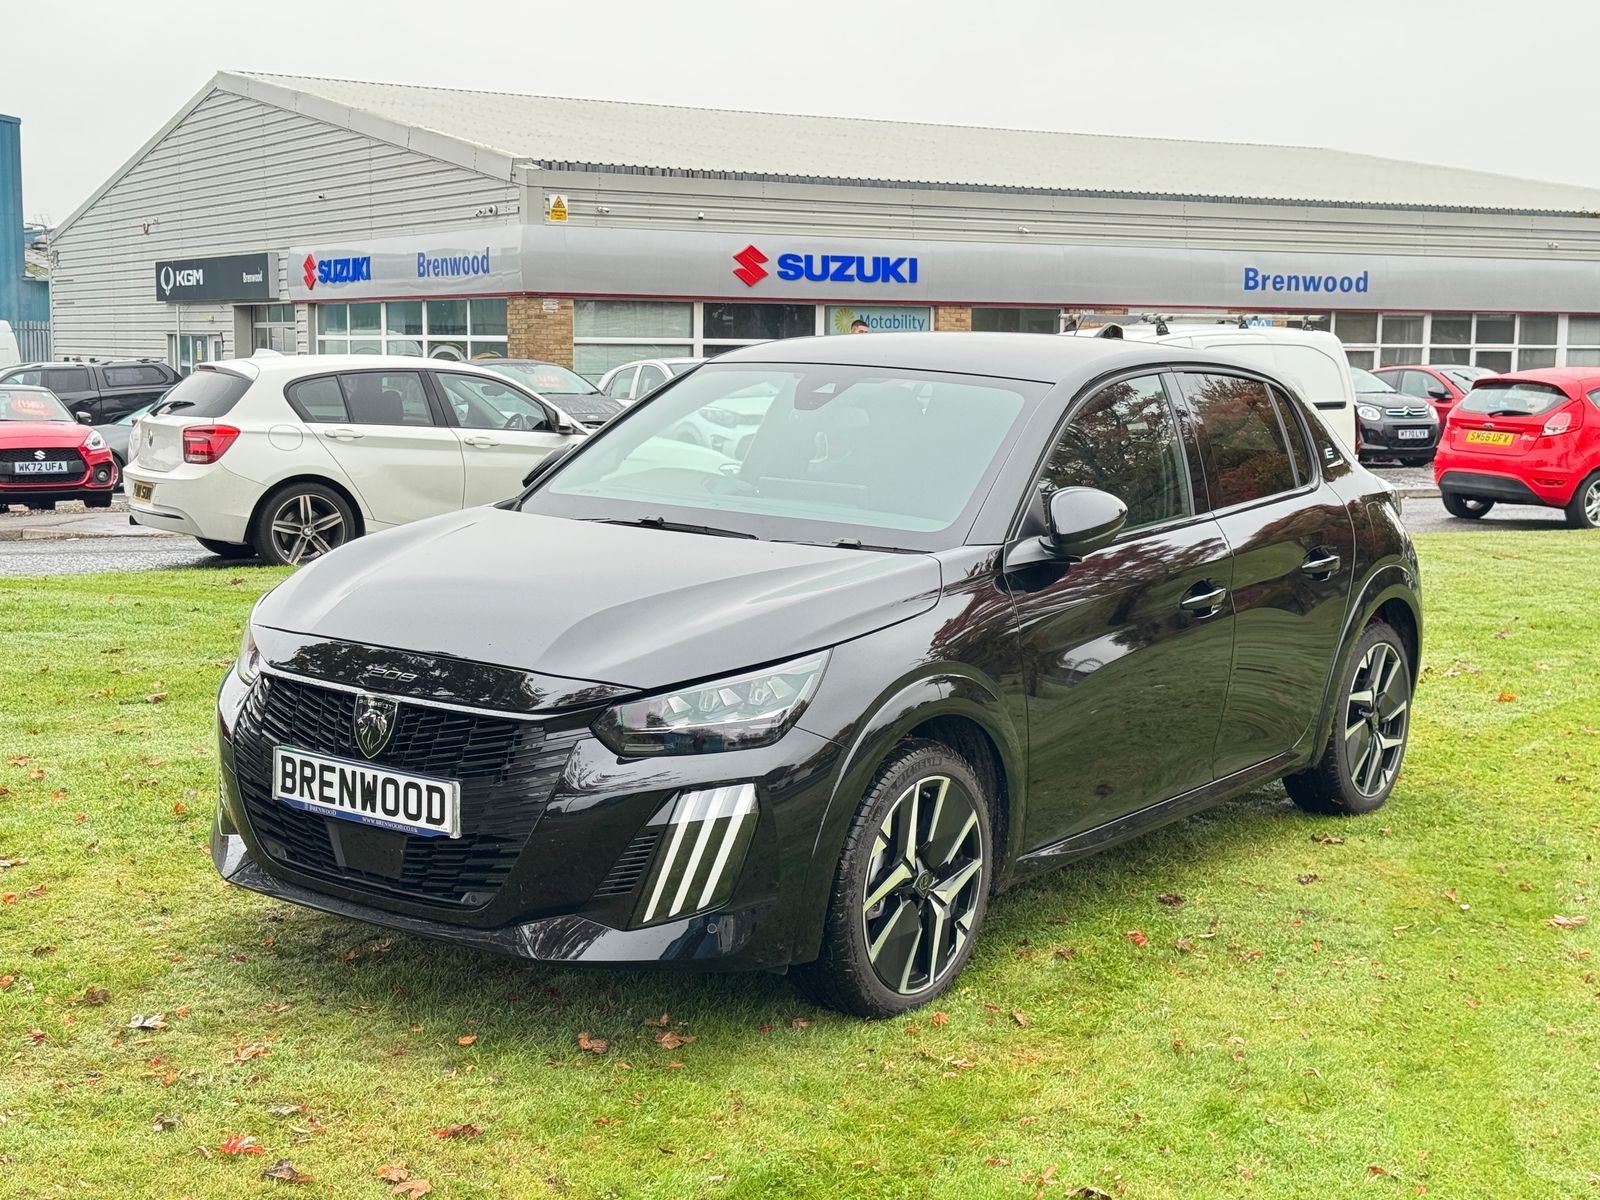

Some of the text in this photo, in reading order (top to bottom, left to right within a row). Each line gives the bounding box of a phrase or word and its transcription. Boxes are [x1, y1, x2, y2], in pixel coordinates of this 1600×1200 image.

[318, 256, 371, 283] SUZUKI
[417, 247, 490, 277] Brenwood
[777, 253, 918, 283] SUZUKI
[176, 269, 204, 286] KGM
[242, 270, 263, 283] Brenwood
[1244, 267, 1368, 293] Brenwood
[860, 314, 925, 331] Motability
[1470, 431, 1492, 442] SM66
[18, 462, 64, 472] WK72 UFA
[368, 668, 418, 682] 208
[280, 755, 446, 826] BRENWOOD
